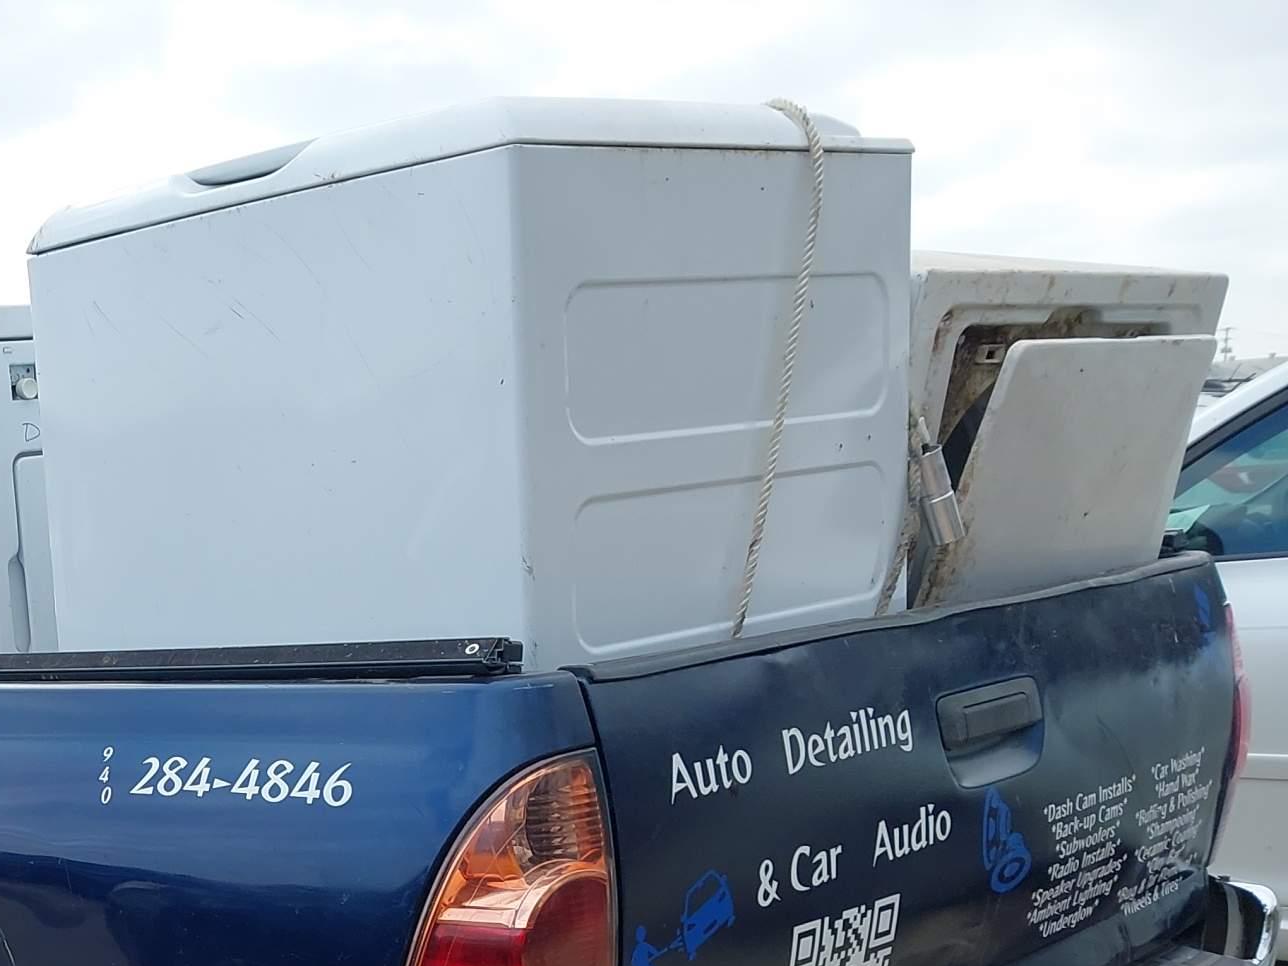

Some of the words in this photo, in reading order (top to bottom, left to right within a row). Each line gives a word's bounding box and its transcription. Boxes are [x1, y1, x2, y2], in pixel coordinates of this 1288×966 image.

[130, 756, 352, 807] 284-4846
[670, 744, 753, 805] Auto
[781, 706, 914, 776] Detailing
[1075, 793, 1097, 811] Cam
[757, 858, 782, 907] &
[790, 844, 843, 892] Car
[872, 802, 953, 867] Audio
